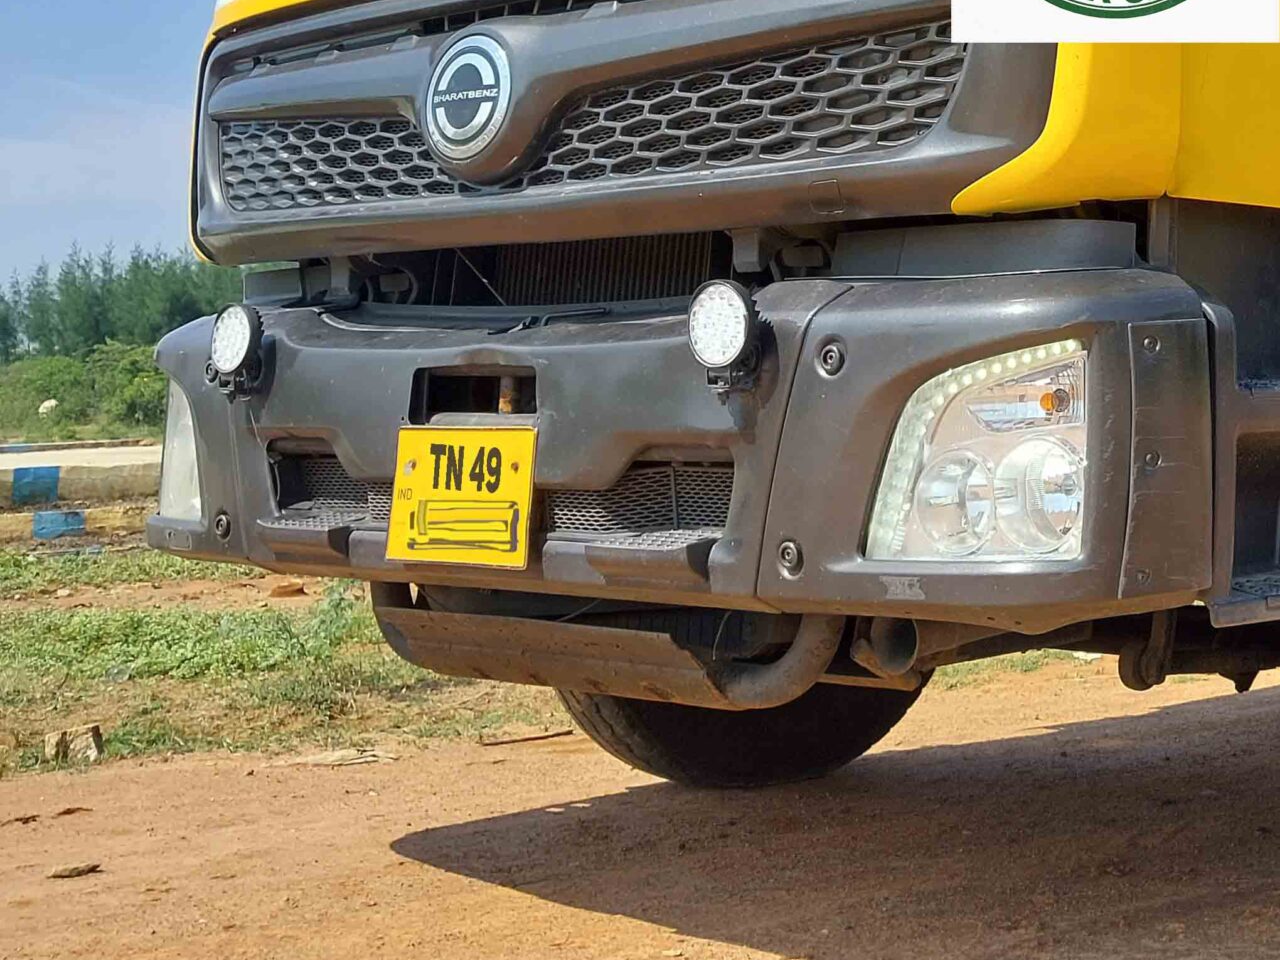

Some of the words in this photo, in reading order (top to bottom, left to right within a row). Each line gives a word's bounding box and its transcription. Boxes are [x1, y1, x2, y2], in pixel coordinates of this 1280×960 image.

[433, 88, 499, 104] BHARATBENZ
[430, 443, 465, 492] TN
[469, 446, 503, 494] 49
[397, 487, 413, 501] IND
